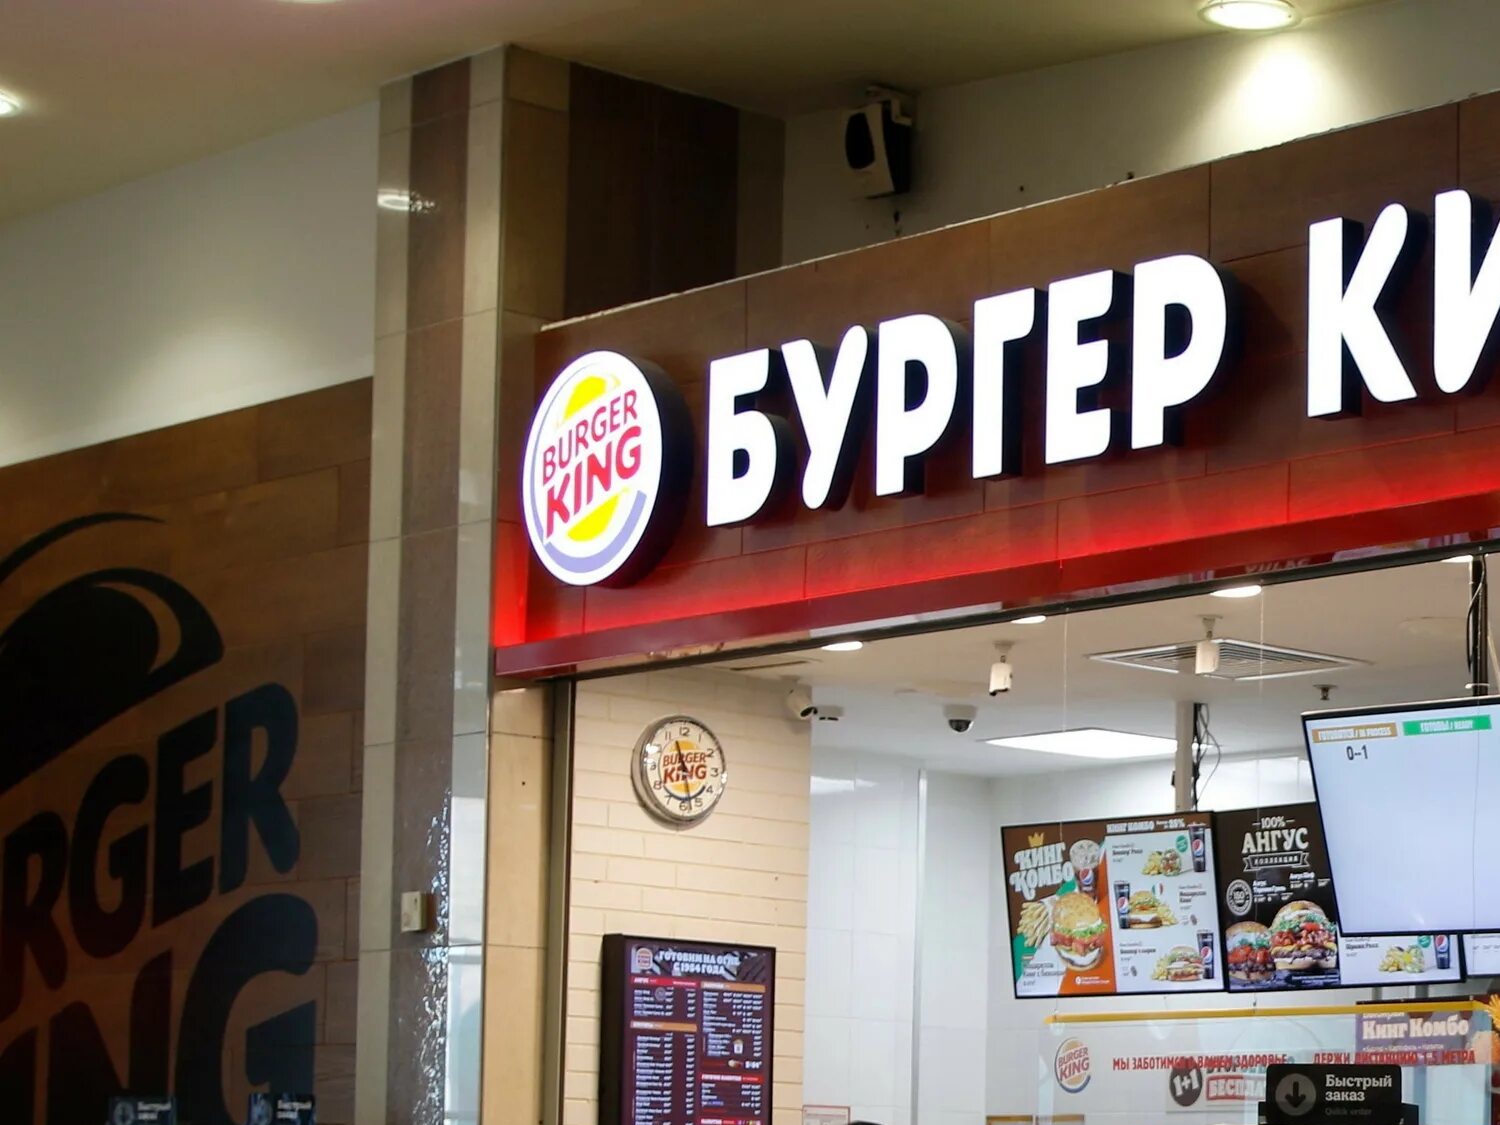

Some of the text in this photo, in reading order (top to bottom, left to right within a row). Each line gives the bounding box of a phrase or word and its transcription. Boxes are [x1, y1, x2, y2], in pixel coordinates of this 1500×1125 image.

[706, 254, 1226, 527] БУРГЕР
[542, 389, 638, 487] BURGER
[543, 423, 641, 541] KING
[663, 751, 707, 766] BURGER
[662, 764, 707, 784] KING
[1261, 816, 1286, 829] 100%
[1242, 827, 1309, 854] АНГУС
[1014, 842, 1066, 871] КИНГ
[1009, 861, 1075, 900] КОМБО
[1362, 1021, 1408, 1040] Кинг
[1409, 1014, 1469, 1037] Комбо
[1058, 1047, 1089, 1068] BURGER
[1113, 1057, 1130, 1071] МЫ
[1235, 1053, 1287, 1068] ЗДОРОВЬЕ
[1313, 1052, 1350, 1065] ДЕРЖИ
[1442, 1050, 1476, 1065] МЕТРА
[1059, 1057, 1090, 1081] KING
[1325, 1074, 1393, 1089] Быстрый
[1325, 1090, 1366, 1102] заказ
